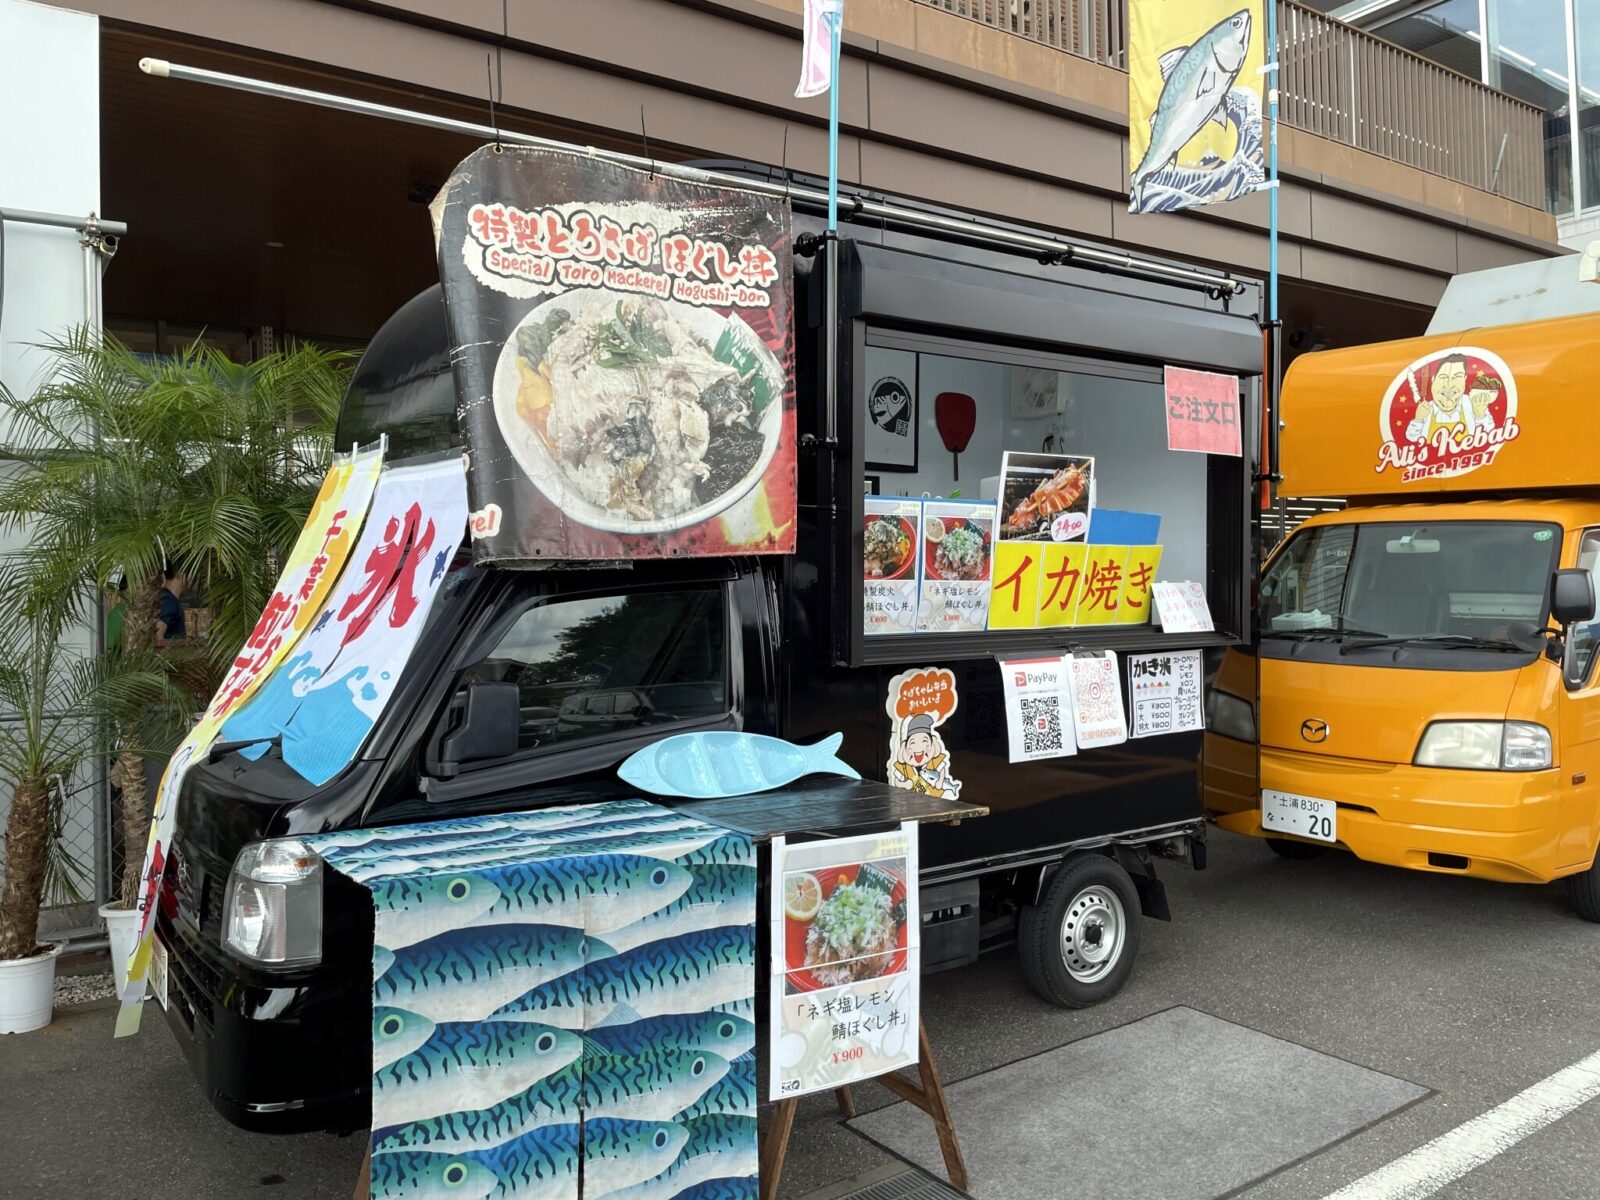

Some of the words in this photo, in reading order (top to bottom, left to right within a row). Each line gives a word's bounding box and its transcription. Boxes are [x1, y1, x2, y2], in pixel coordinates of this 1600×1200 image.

[490, 250, 550, 278] Special
[1169, 395, 1237, 426] ご注文口
[1375, 437, 1429, 473] Ali's
[1431, 417, 1520, 457] Kebab
[1403, 464, 1445, 481] since
[1451, 450, 1495, 471] 1997
[337, 502, 436, 648] 氷
[994, 555, 1153, 613] イカ焼き
[1028, 672, 1058, 685] PayPay
[1133, 657, 1172, 678] かき氷
[797, 990, 895, 1021] 「ネギ塩レモン
[832, 1009, 907, 1041] 鯖ほぐし丼」
[832, 1047, 863, 1064] ¥900
